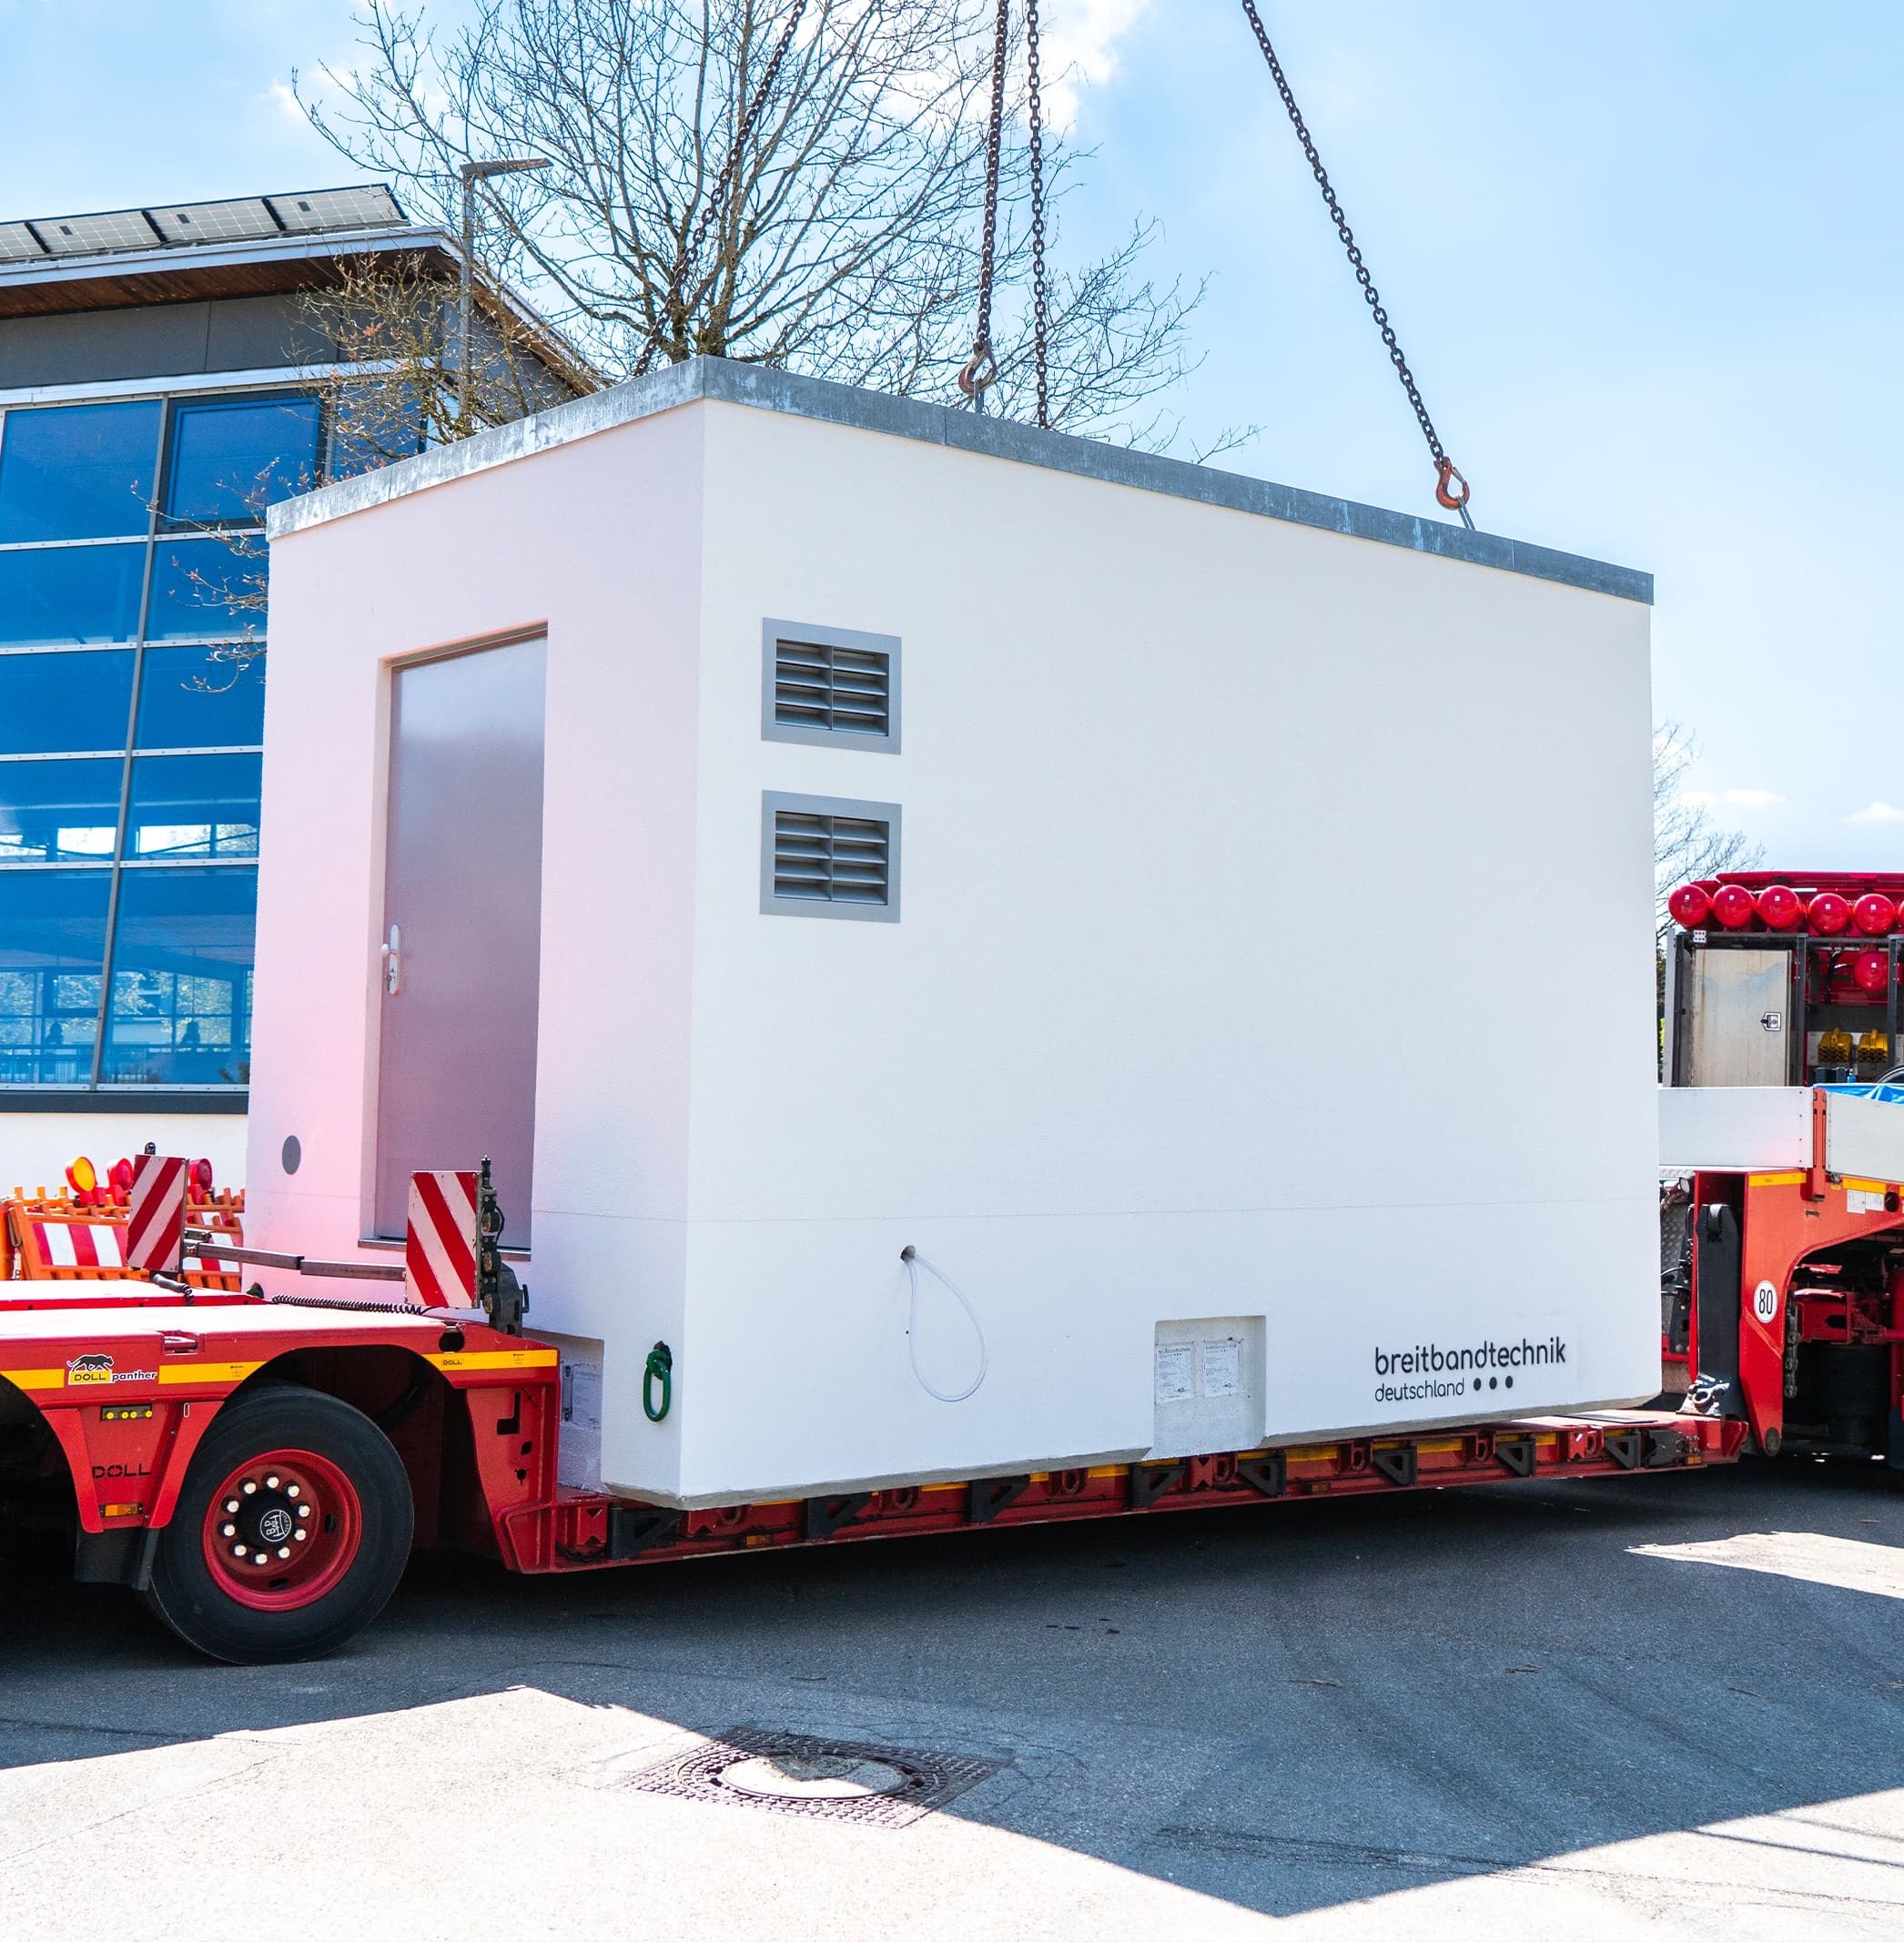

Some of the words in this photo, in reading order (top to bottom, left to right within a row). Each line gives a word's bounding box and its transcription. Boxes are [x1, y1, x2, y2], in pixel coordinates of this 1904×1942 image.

[1758, 1289, 1774, 1315] 80
[1375, 1336, 1566, 1375] breitbandtechnik
[74, 1373, 106, 1381] DOLL
[111, 1371, 157, 1382] panther
[1375, 1377, 1464, 1402] deutschland
[92, 1462, 152, 1479] DOLL
